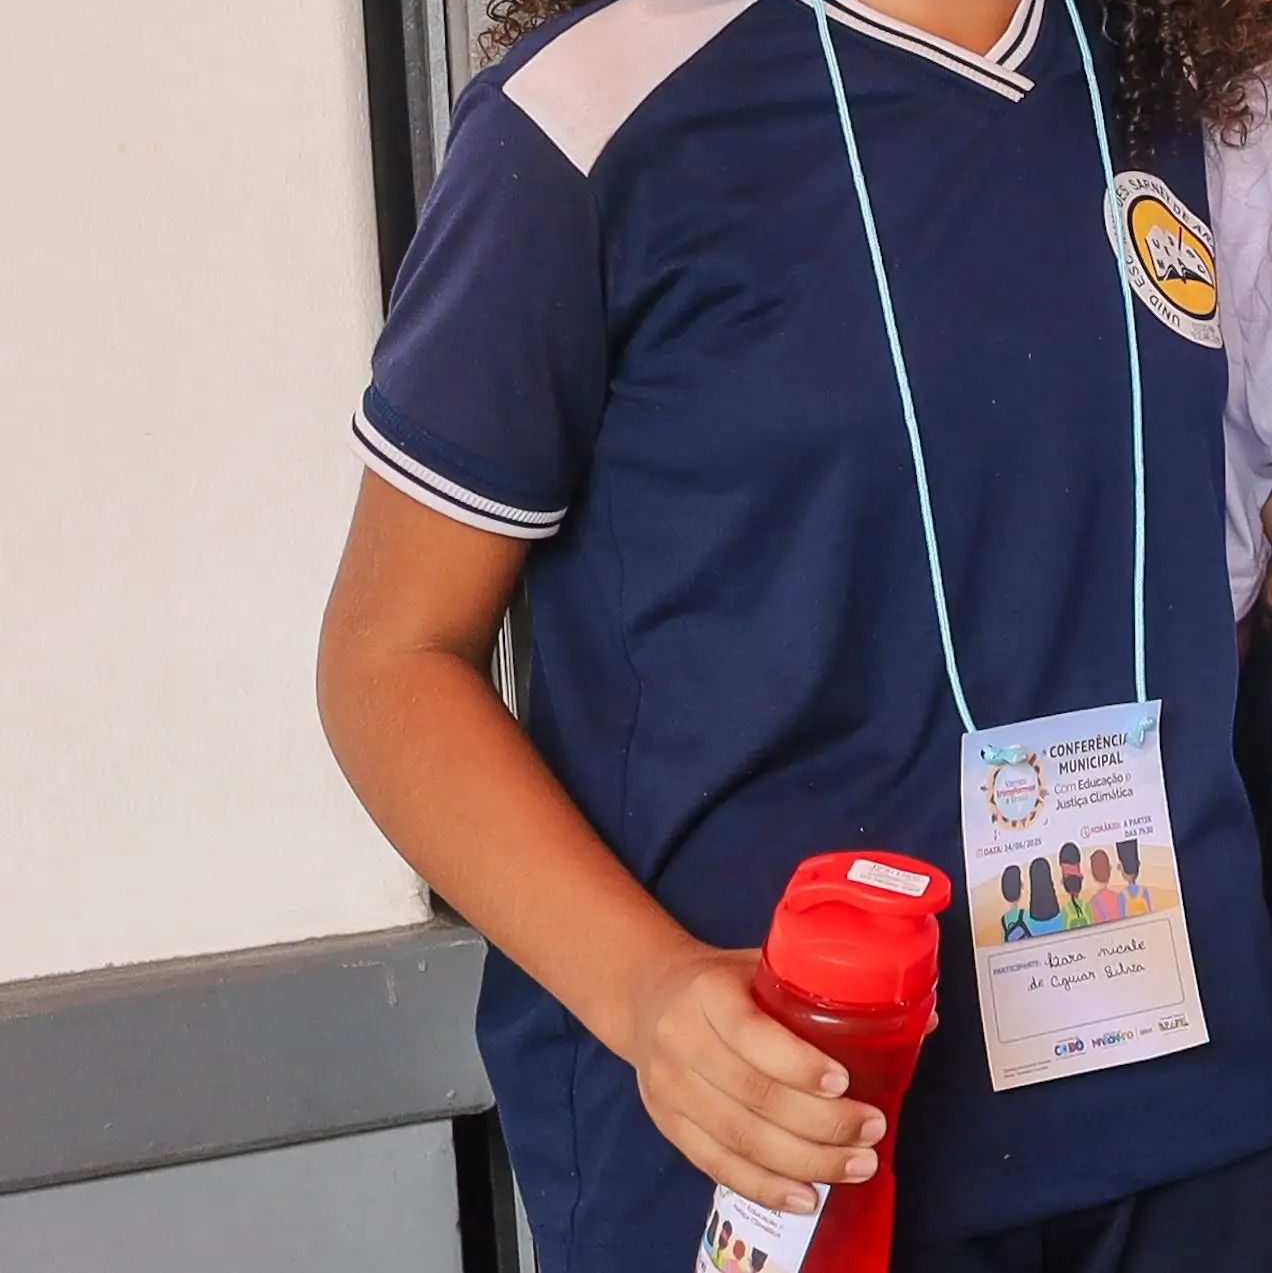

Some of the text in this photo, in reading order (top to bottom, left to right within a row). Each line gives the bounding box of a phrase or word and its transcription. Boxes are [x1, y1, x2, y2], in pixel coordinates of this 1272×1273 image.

[1058, 750, 1124, 775] MUNICIPAL
[1054, 783, 1077, 794] Com
[1077, 773, 1124, 791] Educação
[1055, 788, 1134, 811] Justiça Climática
